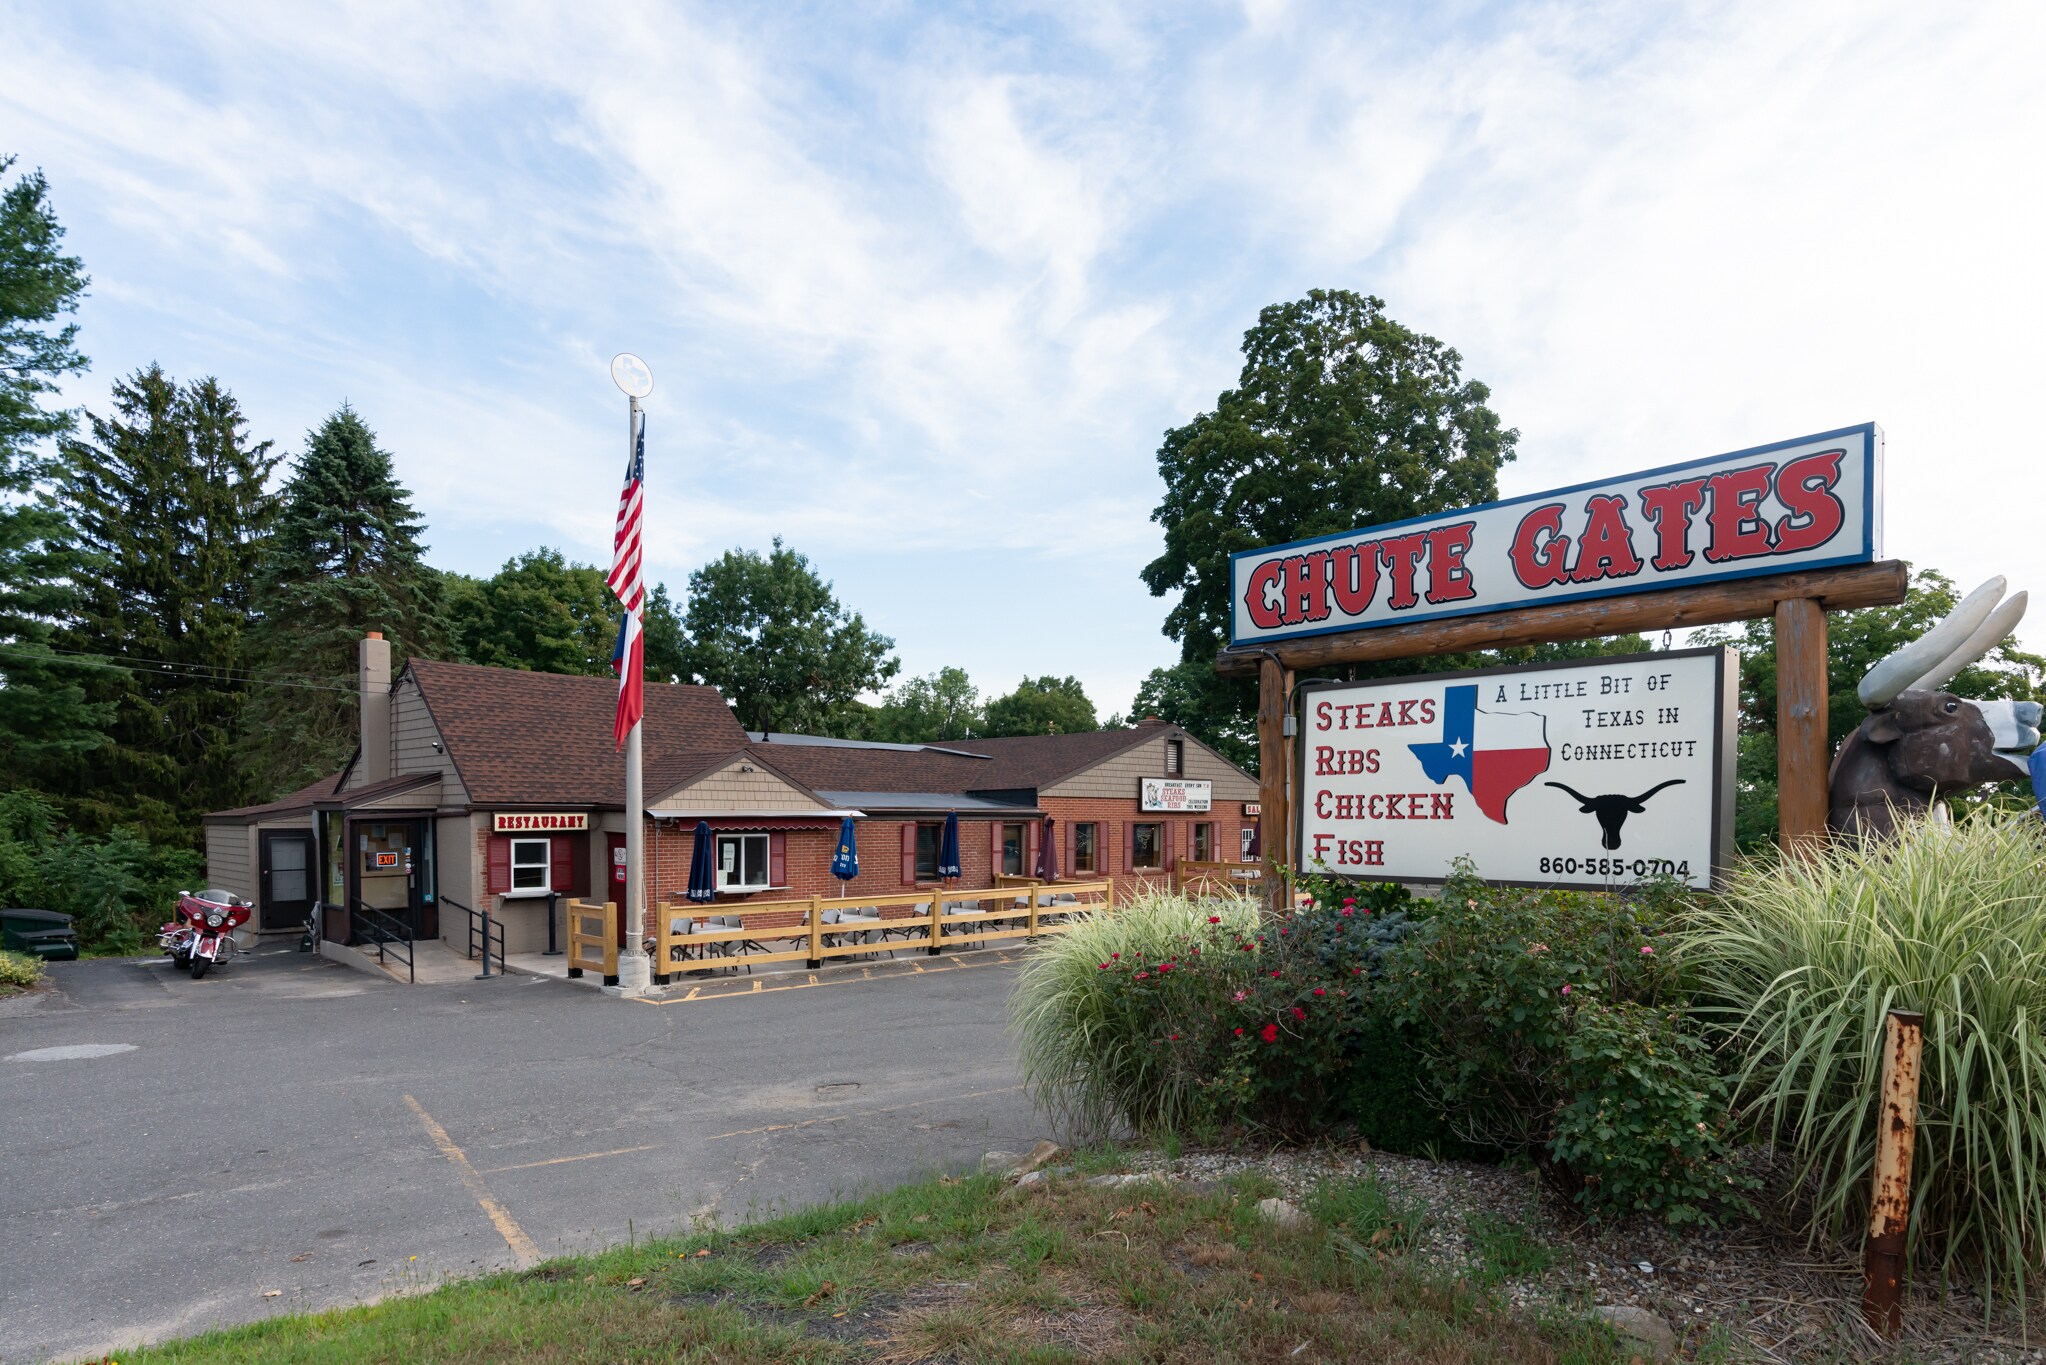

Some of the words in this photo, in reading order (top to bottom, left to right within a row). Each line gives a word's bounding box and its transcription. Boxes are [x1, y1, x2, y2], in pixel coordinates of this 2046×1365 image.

[1244, 520, 1477, 628] CHUTE
[1508, 448, 1846, 590] GATES
[1495, 685, 1507, 702] A
[1520, 681, 1587, 701] LITTLE
[1600, 675, 1633, 695] BIT
[1647, 674, 1672, 691] OF
[1316, 698, 1436, 731] STEAKS
[1582, 709, 1644, 728] TEXAS
[1658, 707, 1679, 724] IN
[1315, 745, 1380, 776] RIBS
[1561, 741, 1697, 761] CONNECTICUT
[1162, 788, 1186, 796] STEAKS
[1314, 789, 1454, 820] CHICKEN
[498, 816, 584, 829] RESTAURANT
[378, 854, 396, 865] EXIT
[1313, 834, 1385, 866] FISH
[1539, 857, 1690, 878] 860-585-0704
